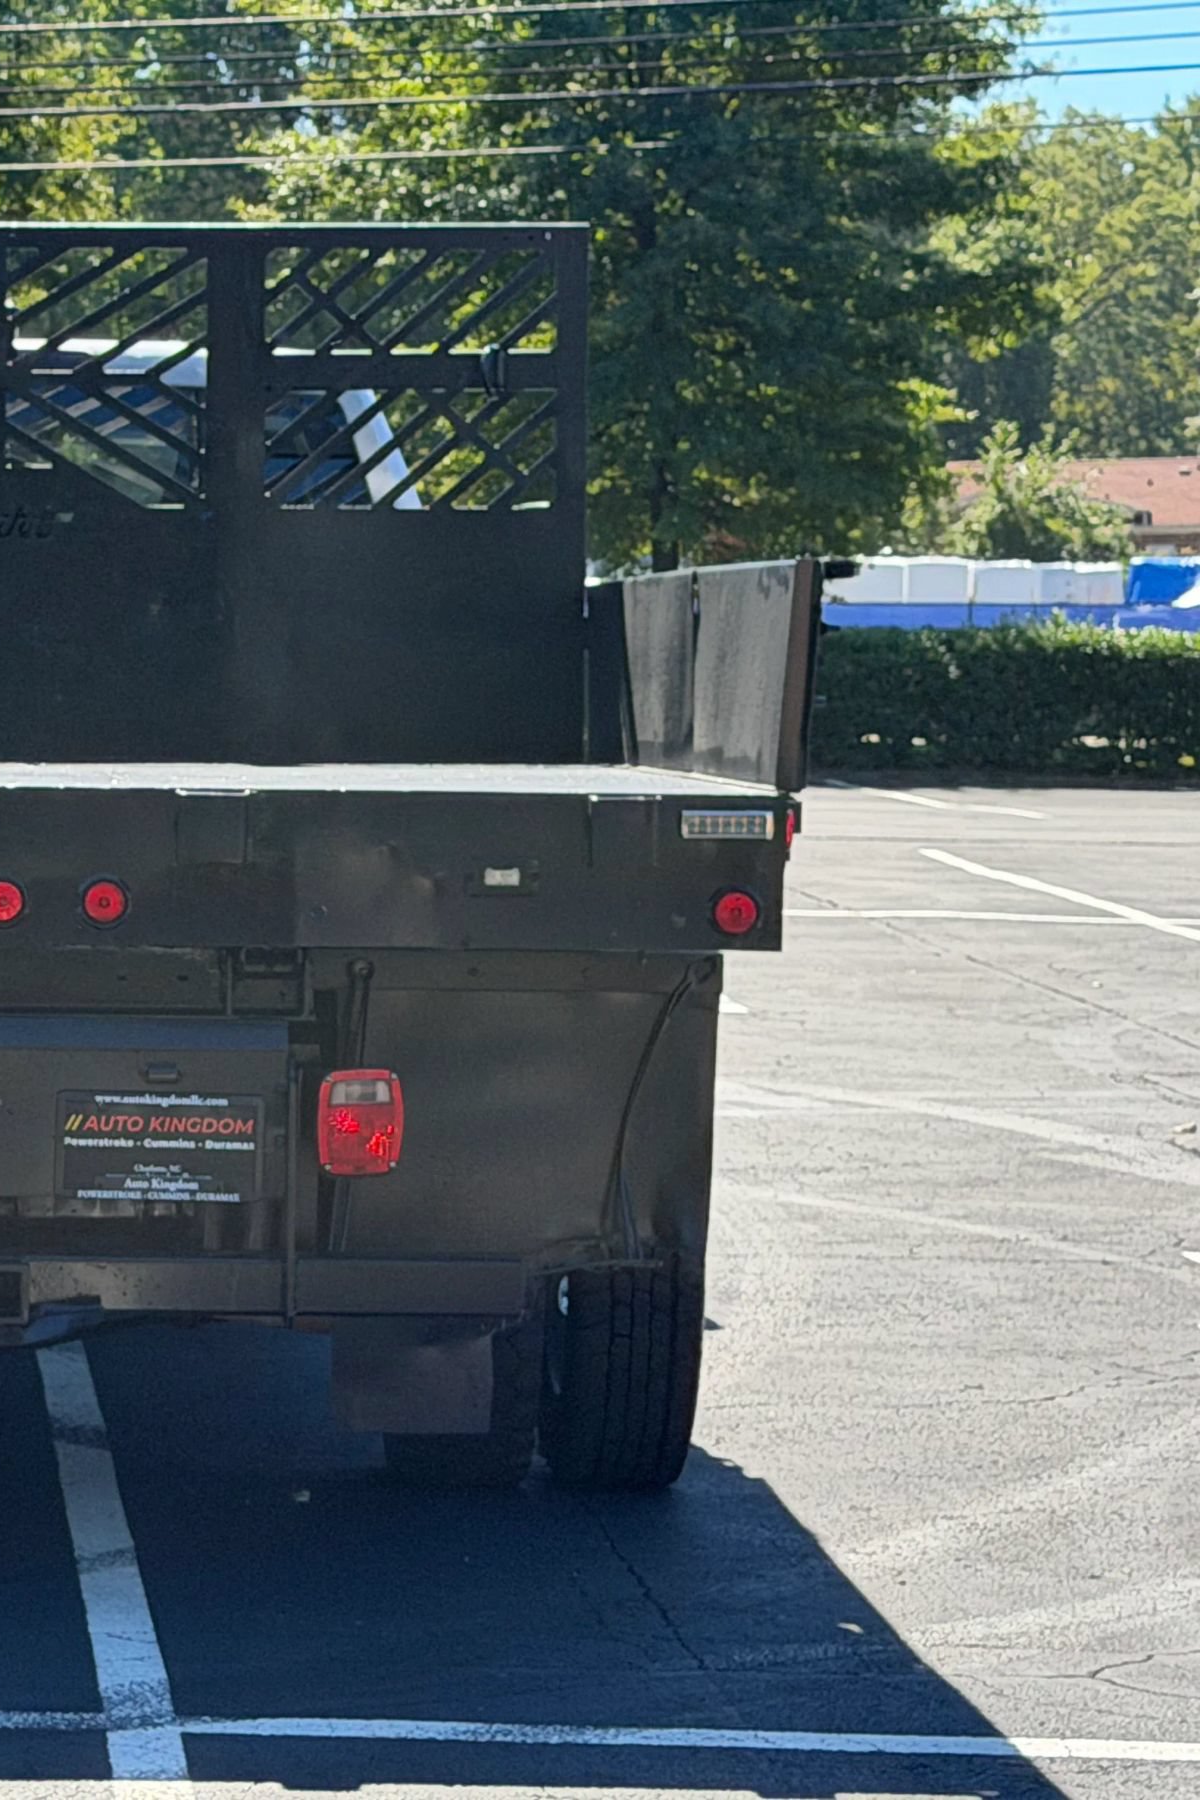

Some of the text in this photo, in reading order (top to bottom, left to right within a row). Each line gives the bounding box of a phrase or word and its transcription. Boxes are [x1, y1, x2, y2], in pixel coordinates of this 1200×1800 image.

[149, 1116, 255, 1135] KINGDOM
[64, 1136, 255, 1150] Powerstroke Cummins Duramax
[123, 1178, 199, 1191] Auto Kingdom
